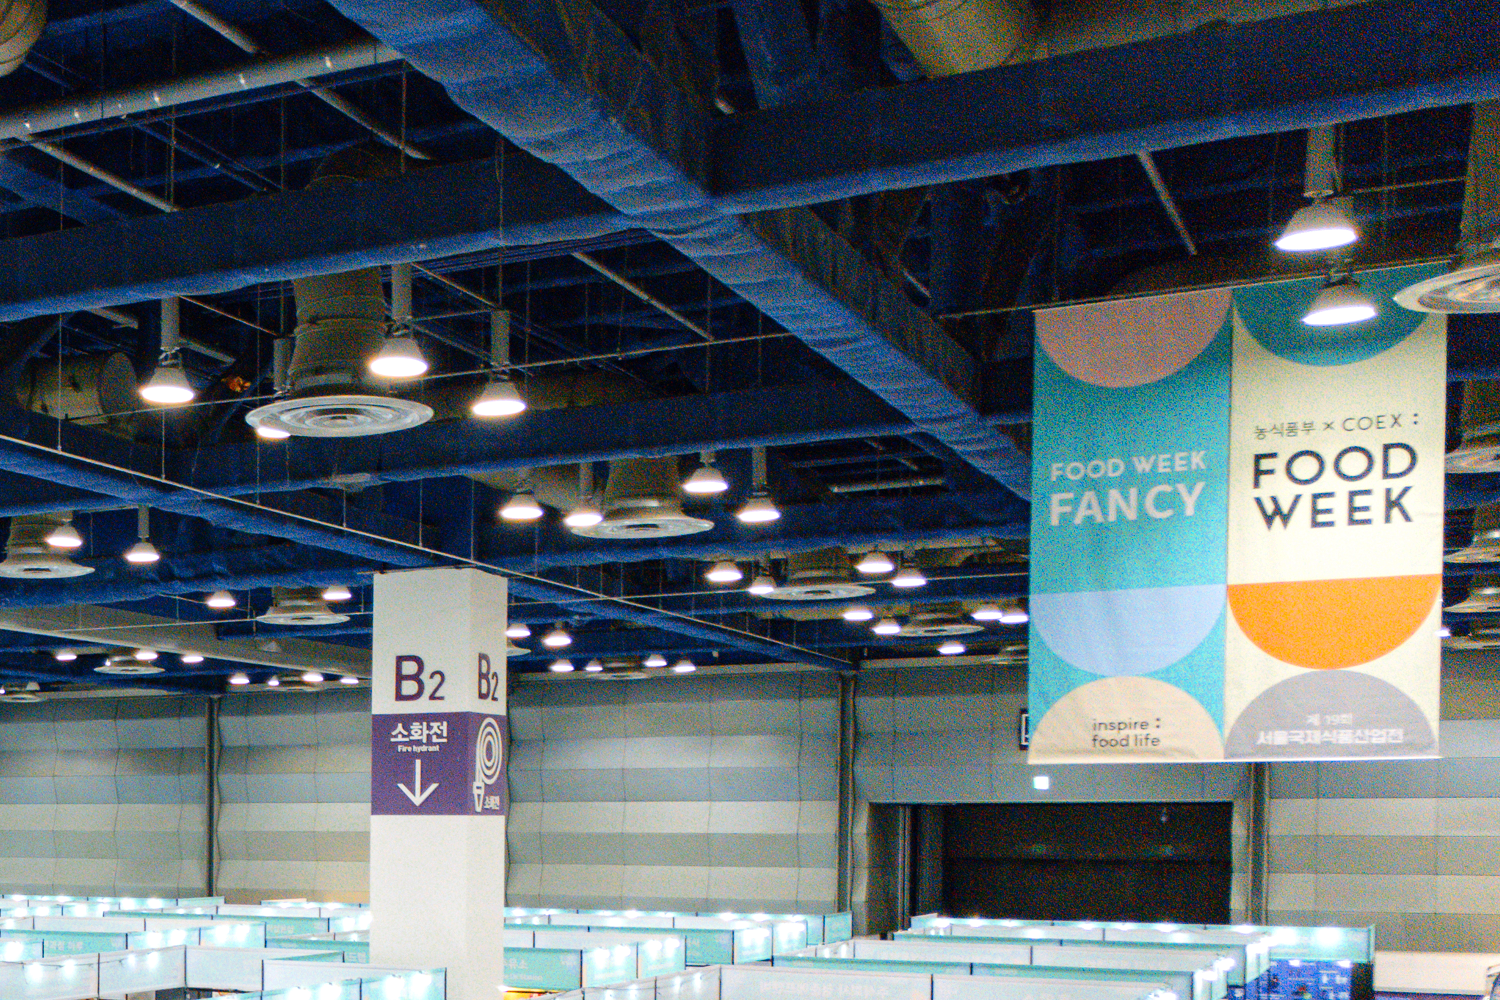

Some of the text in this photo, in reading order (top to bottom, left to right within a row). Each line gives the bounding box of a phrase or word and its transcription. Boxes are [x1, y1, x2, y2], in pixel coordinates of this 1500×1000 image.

[1254, 414, 1403, 440] 농식품부 COEX
[1050, 450, 1207, 482] FOOD WEEK
[1252, 443, 1418, 490] FOOD
[1049, 482, 1205, 527] FANCY
[1254, 486, 1414, 531] WEEK
[394, 654, 446, 702] B2
[477, 652, 499, 702] B2
[390, 720, 448, 743] 소화전
[1092, 717, 1149, 734] inspire
[1256, 728, 1404, 746] 서울국제식품산업전
[397, 744, 440, 754] Fire hydrant
[1091, 733, 1161, 749] food life
